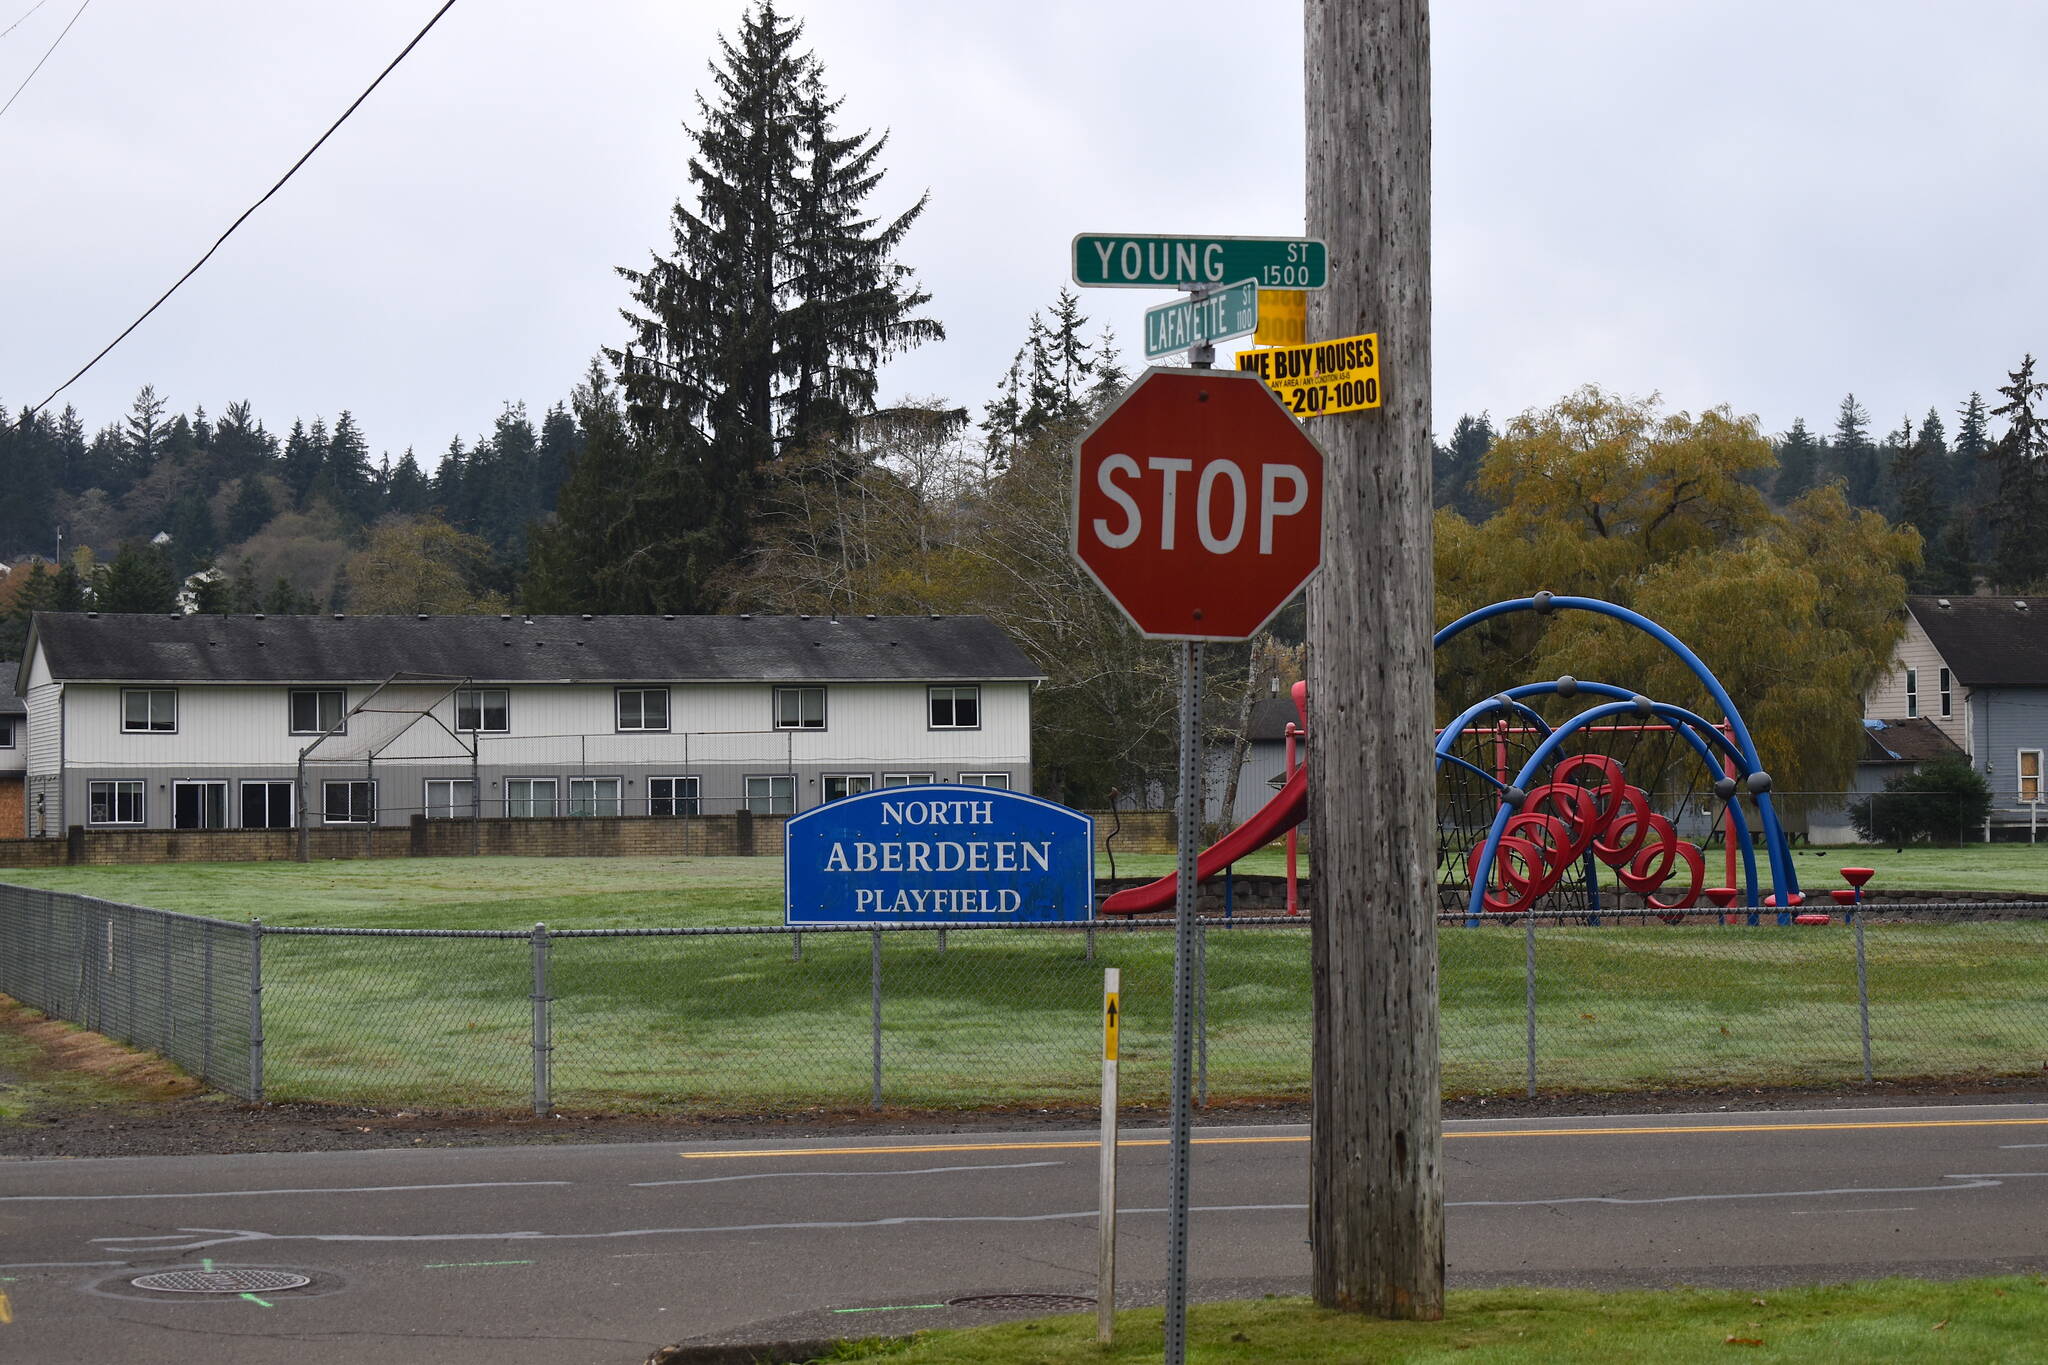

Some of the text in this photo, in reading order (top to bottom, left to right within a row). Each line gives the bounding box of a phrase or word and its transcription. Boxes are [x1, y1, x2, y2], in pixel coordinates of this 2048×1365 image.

[1094, 241, 1309, 281] YOUNG ST
[1263, 265, 1309, 286] 1500
[1150, 294, 1228, 351] LAFAYETTE
[1242, 284, 1252, 306] ST
[1236, 308, 1252, 331] 1100
[1274, 348, 1313, 379] BUY
[1316, 338, 1374, 374] HOUSES
[1271, 380, 1283, 388] ANY
[1284, 378, 1299, 387] AREA
[1303, 377, 1314, 386] ANY
[1314, 374, 1338, 385] CONDITION
[1093, 453, 1309, 555] STOP
[881, 801, 993, 825] NORTH
[824, 841, 1051, 872] ABERDEEN
[855, 889, 1021, 913] PLAYFIELD
